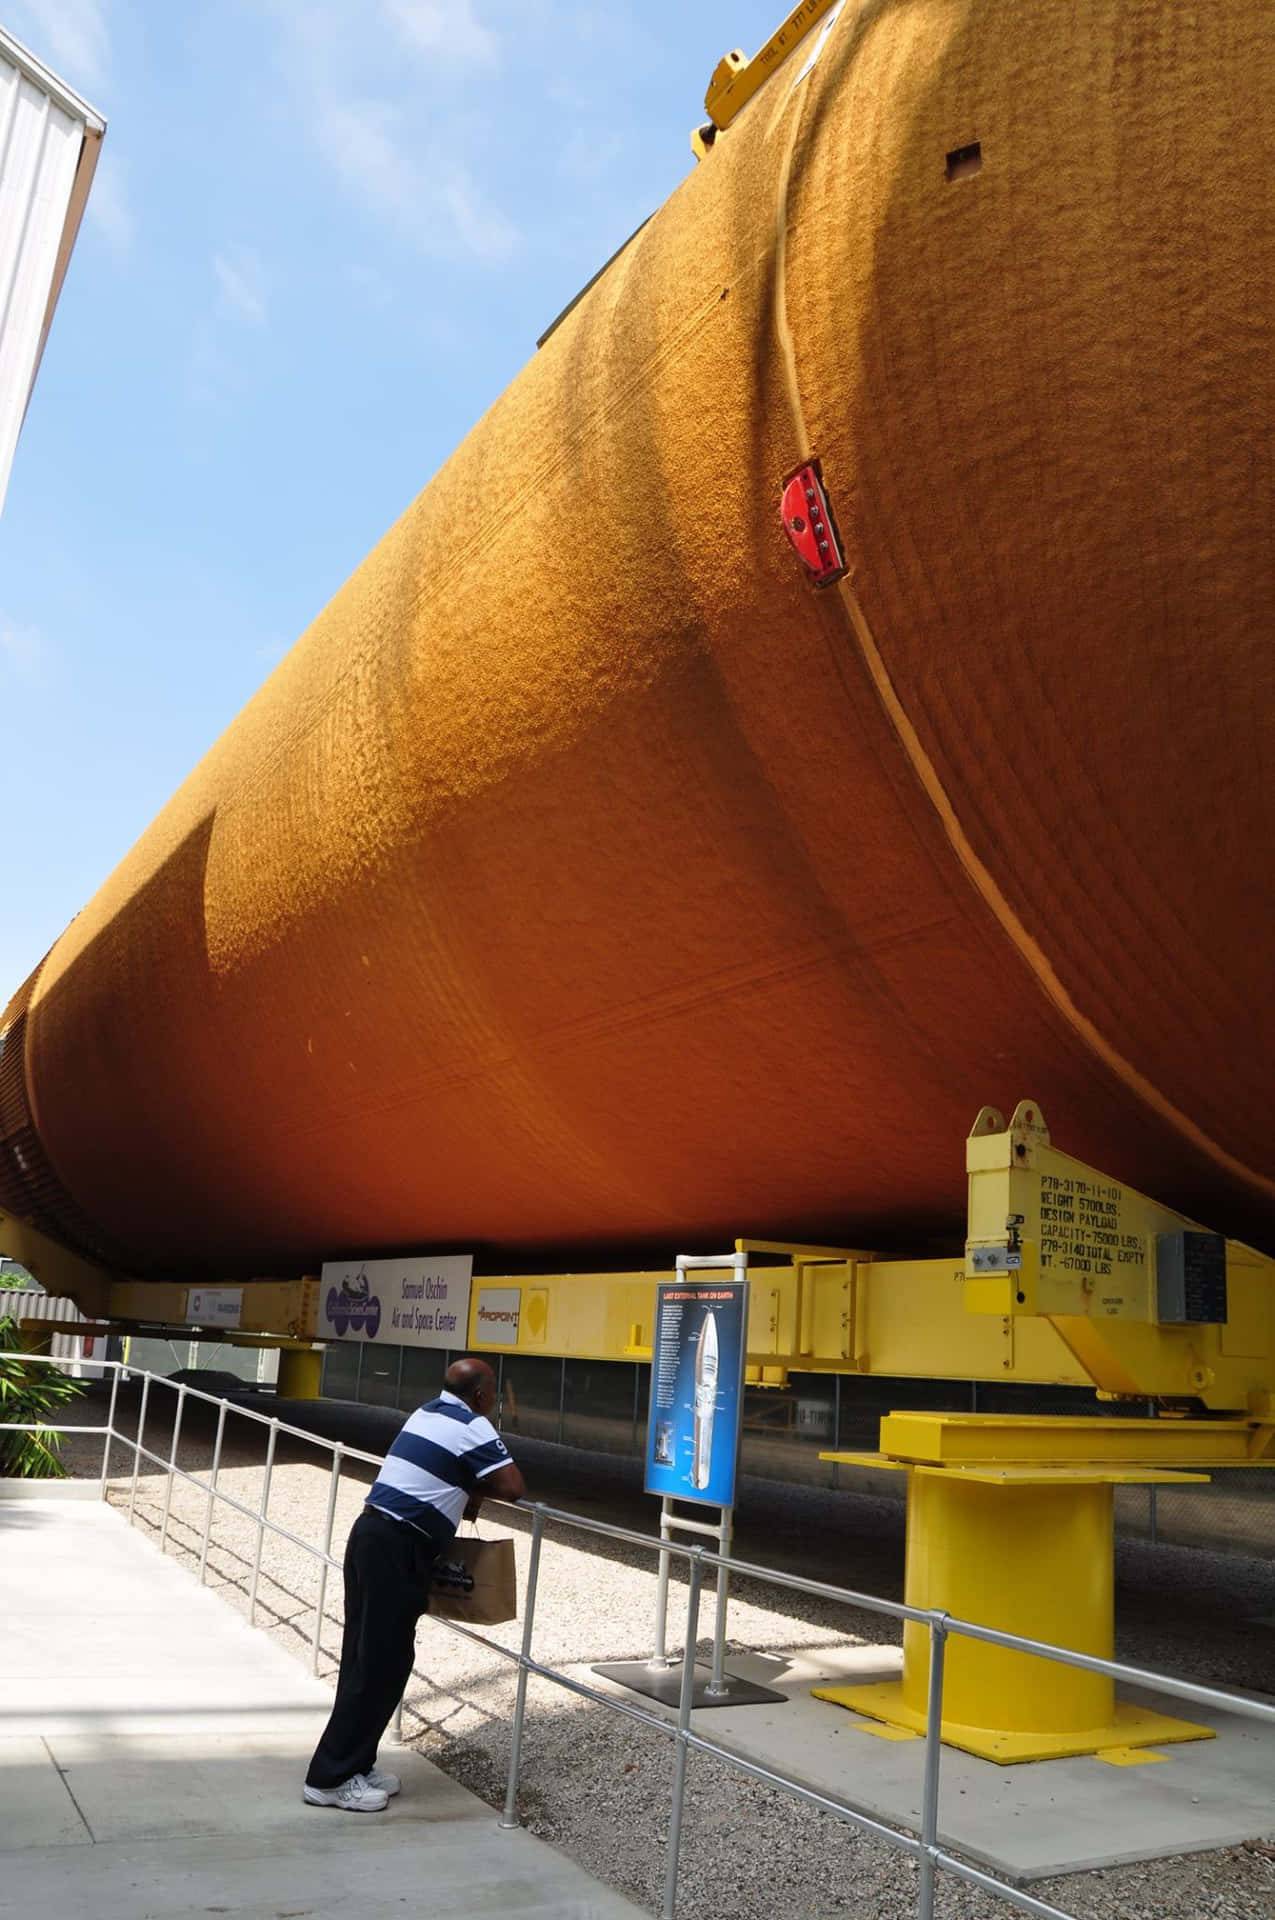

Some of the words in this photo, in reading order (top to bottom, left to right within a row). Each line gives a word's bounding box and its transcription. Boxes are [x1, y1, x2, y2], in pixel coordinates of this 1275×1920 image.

[1041, 1191, 1074, 1209] WEIGHT
[1041, 1207, 1075, 1223] DESIGN
[1080, 1213, 1118, 1230] PAYLOAD
[1118, 1250, 1145, 1265] EMPTY
[1095, 1261, 1112, 1275] LBS
[402, 1277, 425, 1299] Samuel
[426, 1274, 448, 1300] Oschin
[391, 1306, 401, 1329] Air
[401, 1308, 414, 1329] and
[415, 1307, 433, 1336] Space
[435, 1307, 457, 1332] Center
